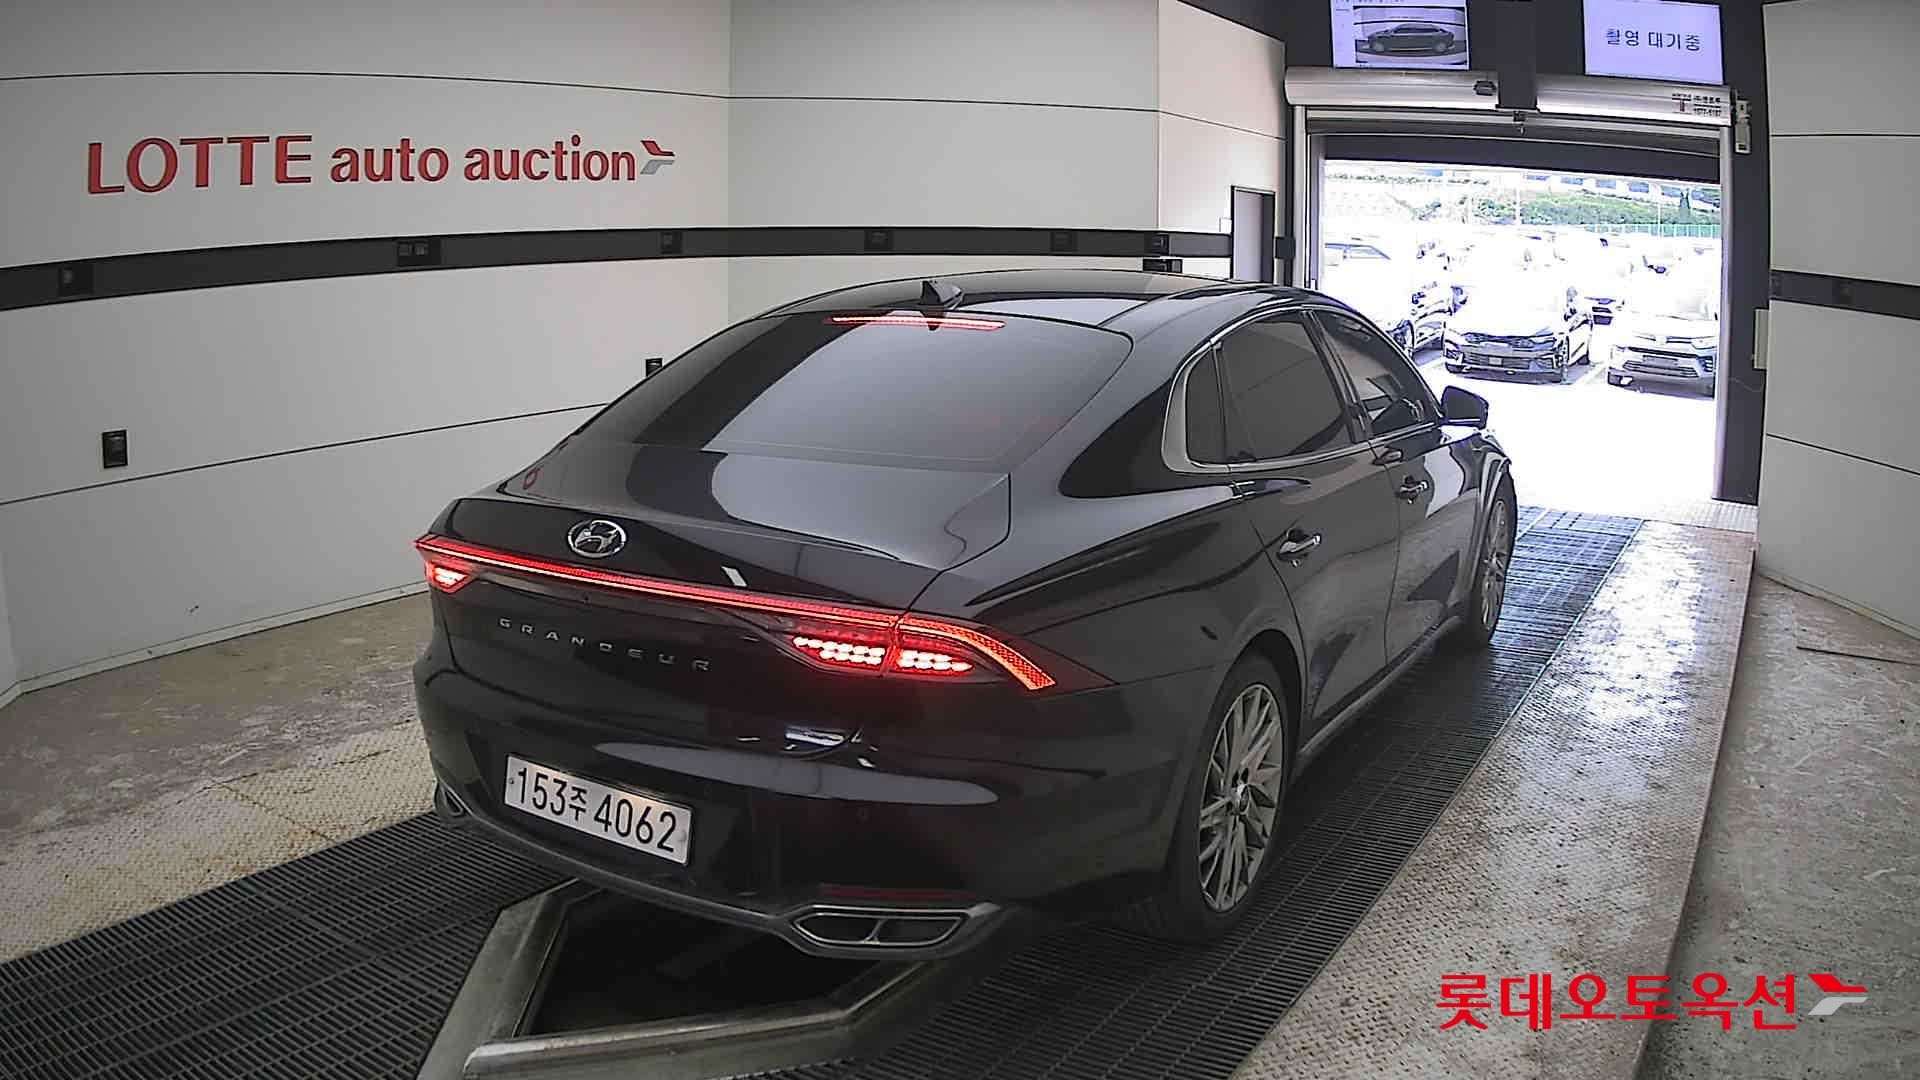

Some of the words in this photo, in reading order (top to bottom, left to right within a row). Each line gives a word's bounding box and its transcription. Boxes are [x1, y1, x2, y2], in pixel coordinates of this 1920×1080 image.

[87, 135, 312, 194] LOTTE
[330, 138, 450, 183] auto
[463, 135, 636, 182] auction
[498, 617, 711, 672] GRANDEUR
